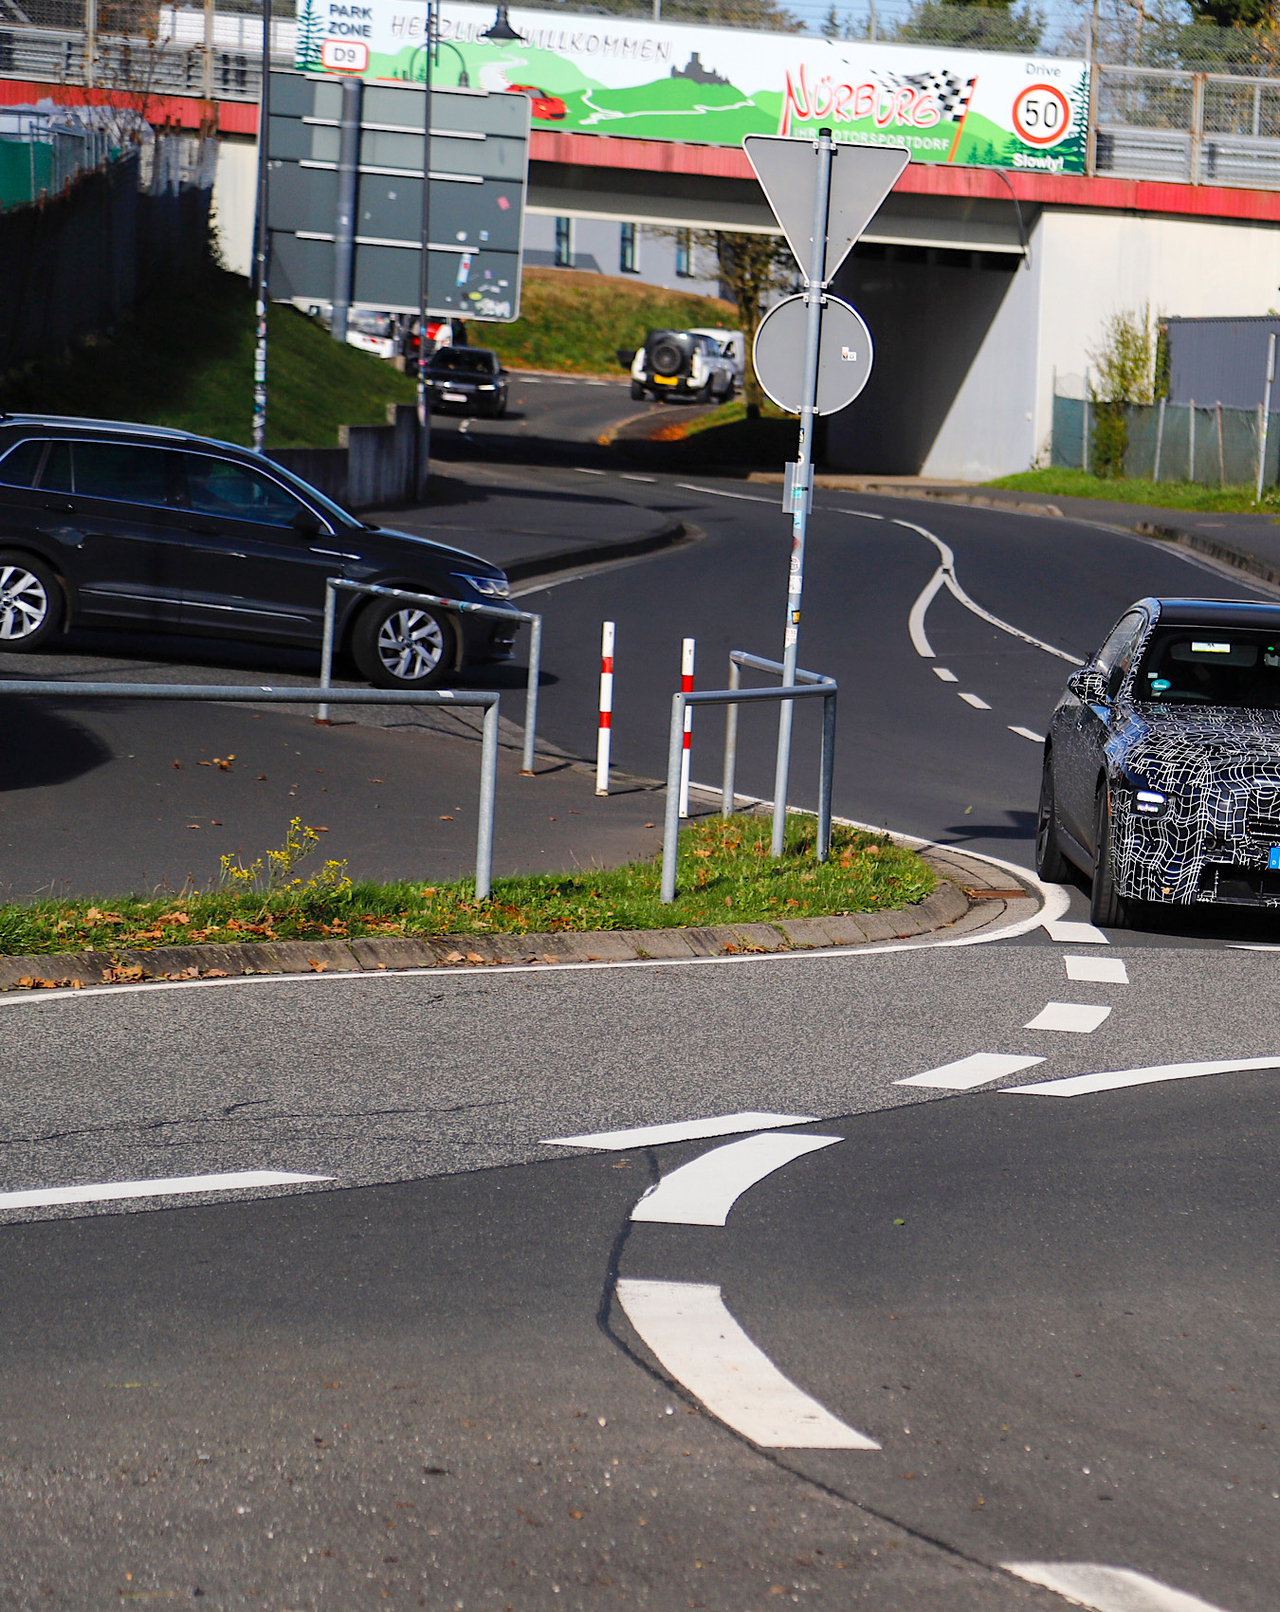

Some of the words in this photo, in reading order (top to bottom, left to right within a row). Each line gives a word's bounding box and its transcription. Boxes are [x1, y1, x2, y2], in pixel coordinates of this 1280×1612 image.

[329, 3, 373, 20] PARK
[328, 21, 372, 38] ZONE
[391, 14, 508, 45] HEZLIC
[518, 26, 673, 62] WILLKOMMEN
[333, 47, 357, 63] D9
[1025, 62, 1063, 78] Drive
[781, 62, 941, 136] NÜRBURG
[1024, 99, 1059, 129] 50
[820, 128, 950, 151] OTORSPORTDORF
[1012, 152, 1065, 173] Slowly!
